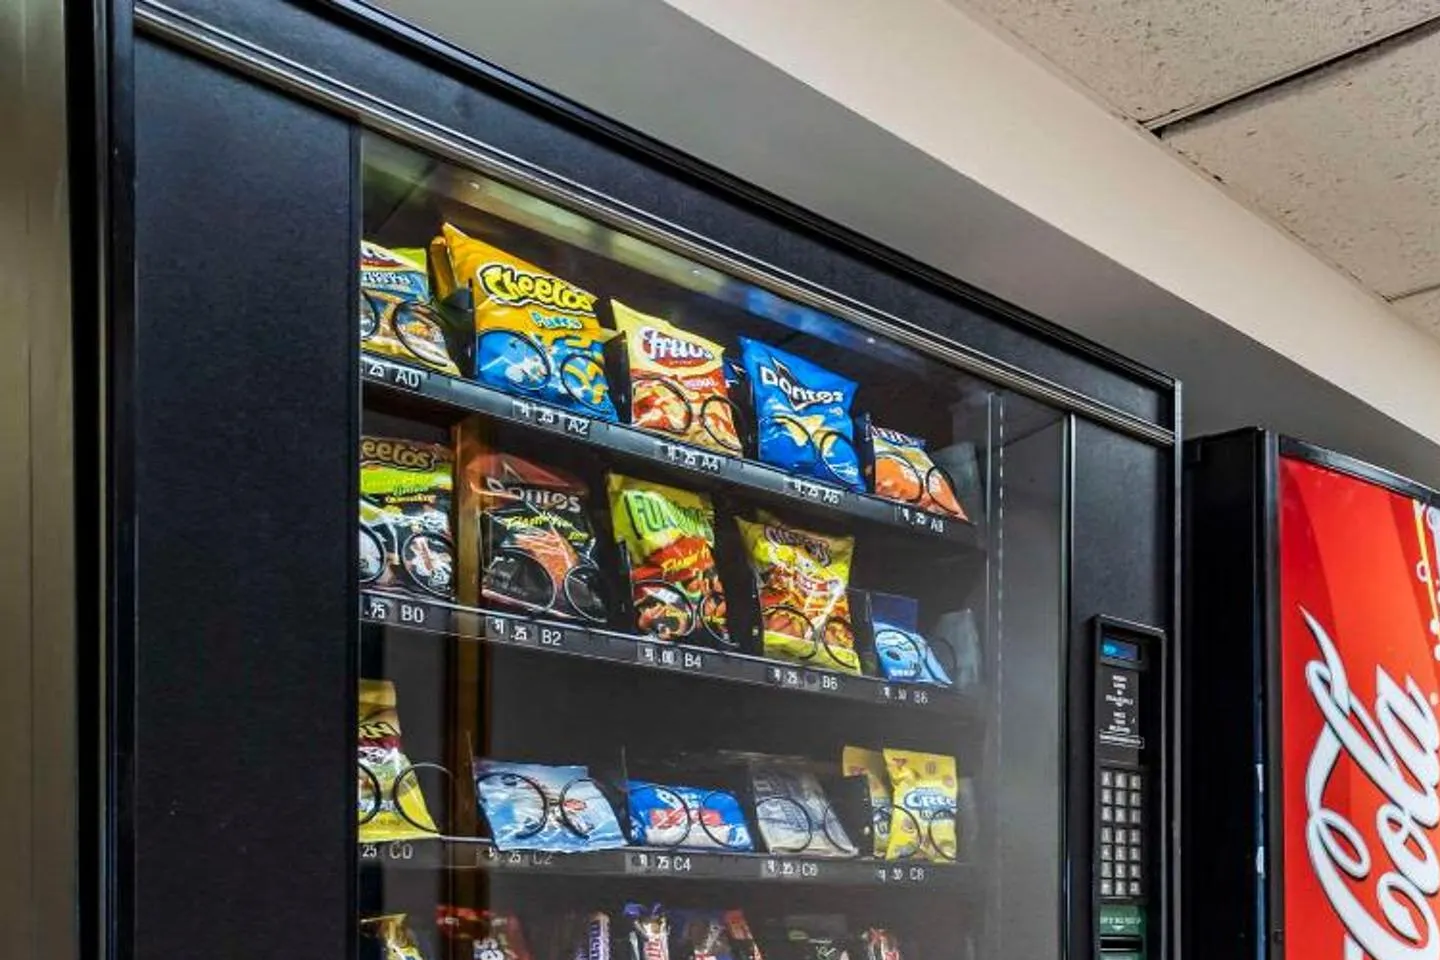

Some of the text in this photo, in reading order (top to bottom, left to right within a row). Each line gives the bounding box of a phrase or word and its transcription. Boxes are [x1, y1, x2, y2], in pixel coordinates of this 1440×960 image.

[480, 264, 595, 311] Cheetos
[759, 366, 844, 405] Doritos
[567, 418, 589, 434] A2
[361, 440, 431, 467] eetos
[401, 604, 425, 624] B0
[541, 629, 562, 647] B2
[684, 653, 702, 669] B4
[673, 857, 692, 872] C4
